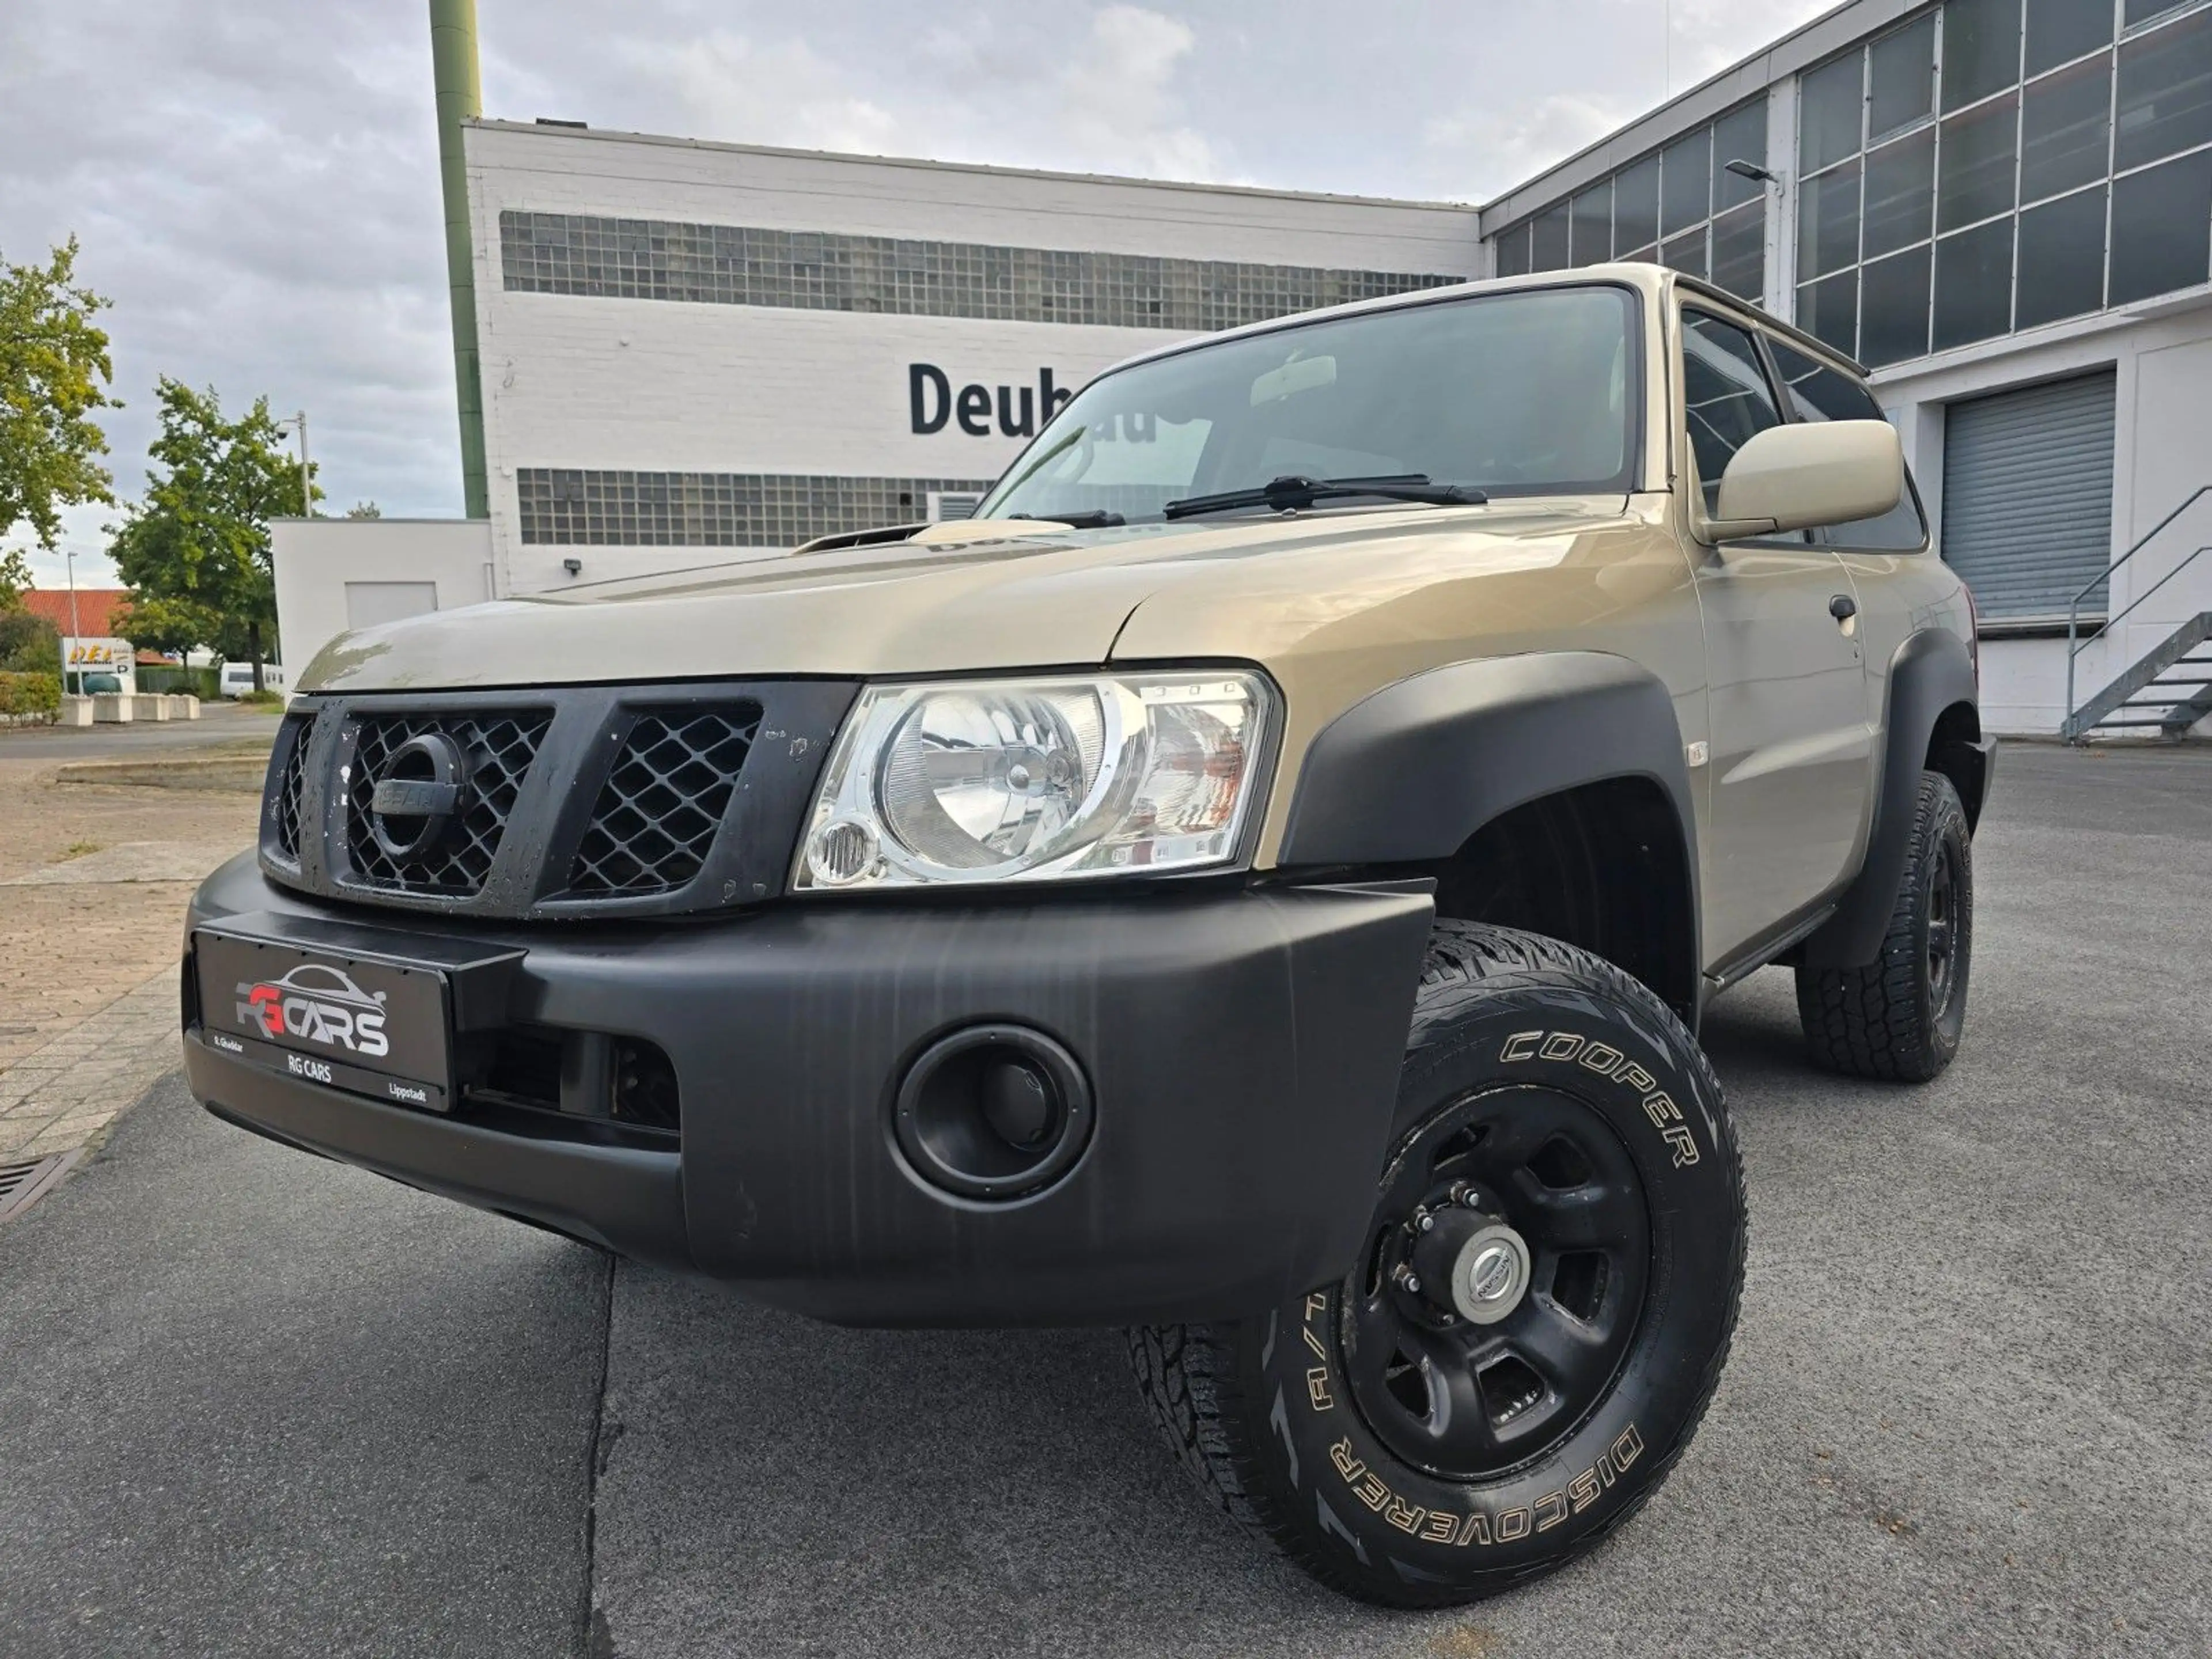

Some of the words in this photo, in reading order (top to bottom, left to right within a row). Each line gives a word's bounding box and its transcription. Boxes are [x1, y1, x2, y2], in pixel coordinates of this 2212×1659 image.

[287, 1054, 303, 1074] RG
[304, 1059, 332, 1084] CARS
[388, 1082, 427, 1103] Lippstadt
[1499, 1030, 1700, 1169] COOPER
[1330, 1422, 1645, 1547] DISCOVERER
